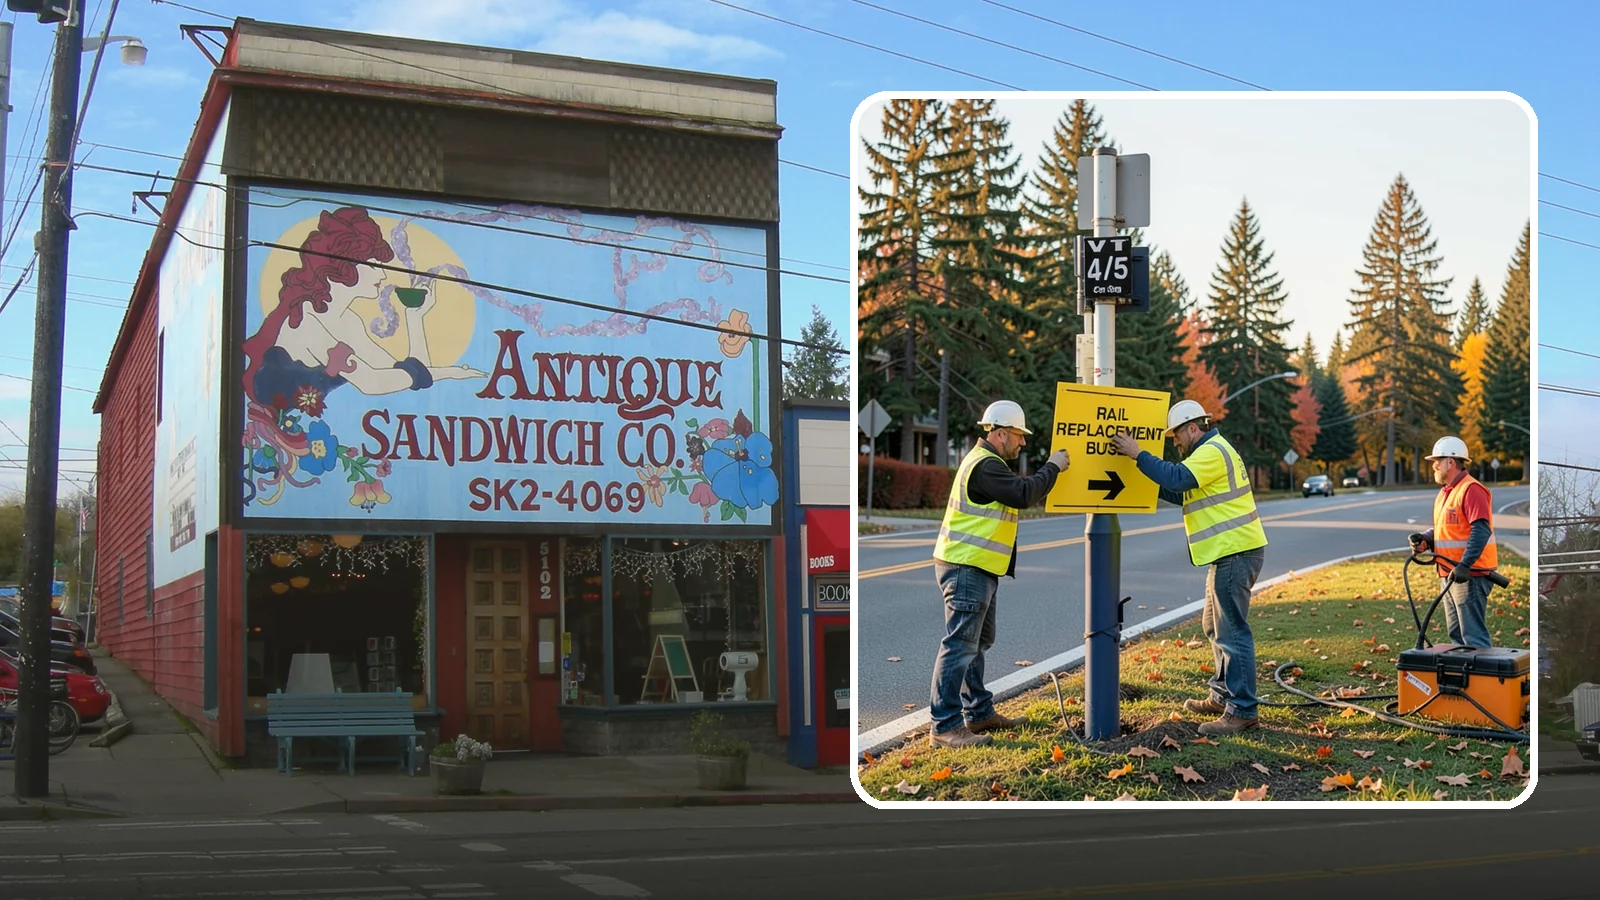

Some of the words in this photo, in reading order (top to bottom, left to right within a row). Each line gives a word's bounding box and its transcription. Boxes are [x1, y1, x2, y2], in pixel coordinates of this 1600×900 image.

[1087, 256, 1128, 280] 4/5
[475, 329, 723, 420] ANTIQUE
[1096, 406, 1128, 421] RAIL
[361, 408, 604, 467] SANDWICH
[617, 422, 685, 468] CO.
[1056, 422, 1164, 441] REPLACEMENT
[1086, 441, 1126, 456] BUS
[468, 477, 645, 512] SK2-4069
[540, 541, 551, 599] 5102
[809, 555, 834, 568] BOOKS
